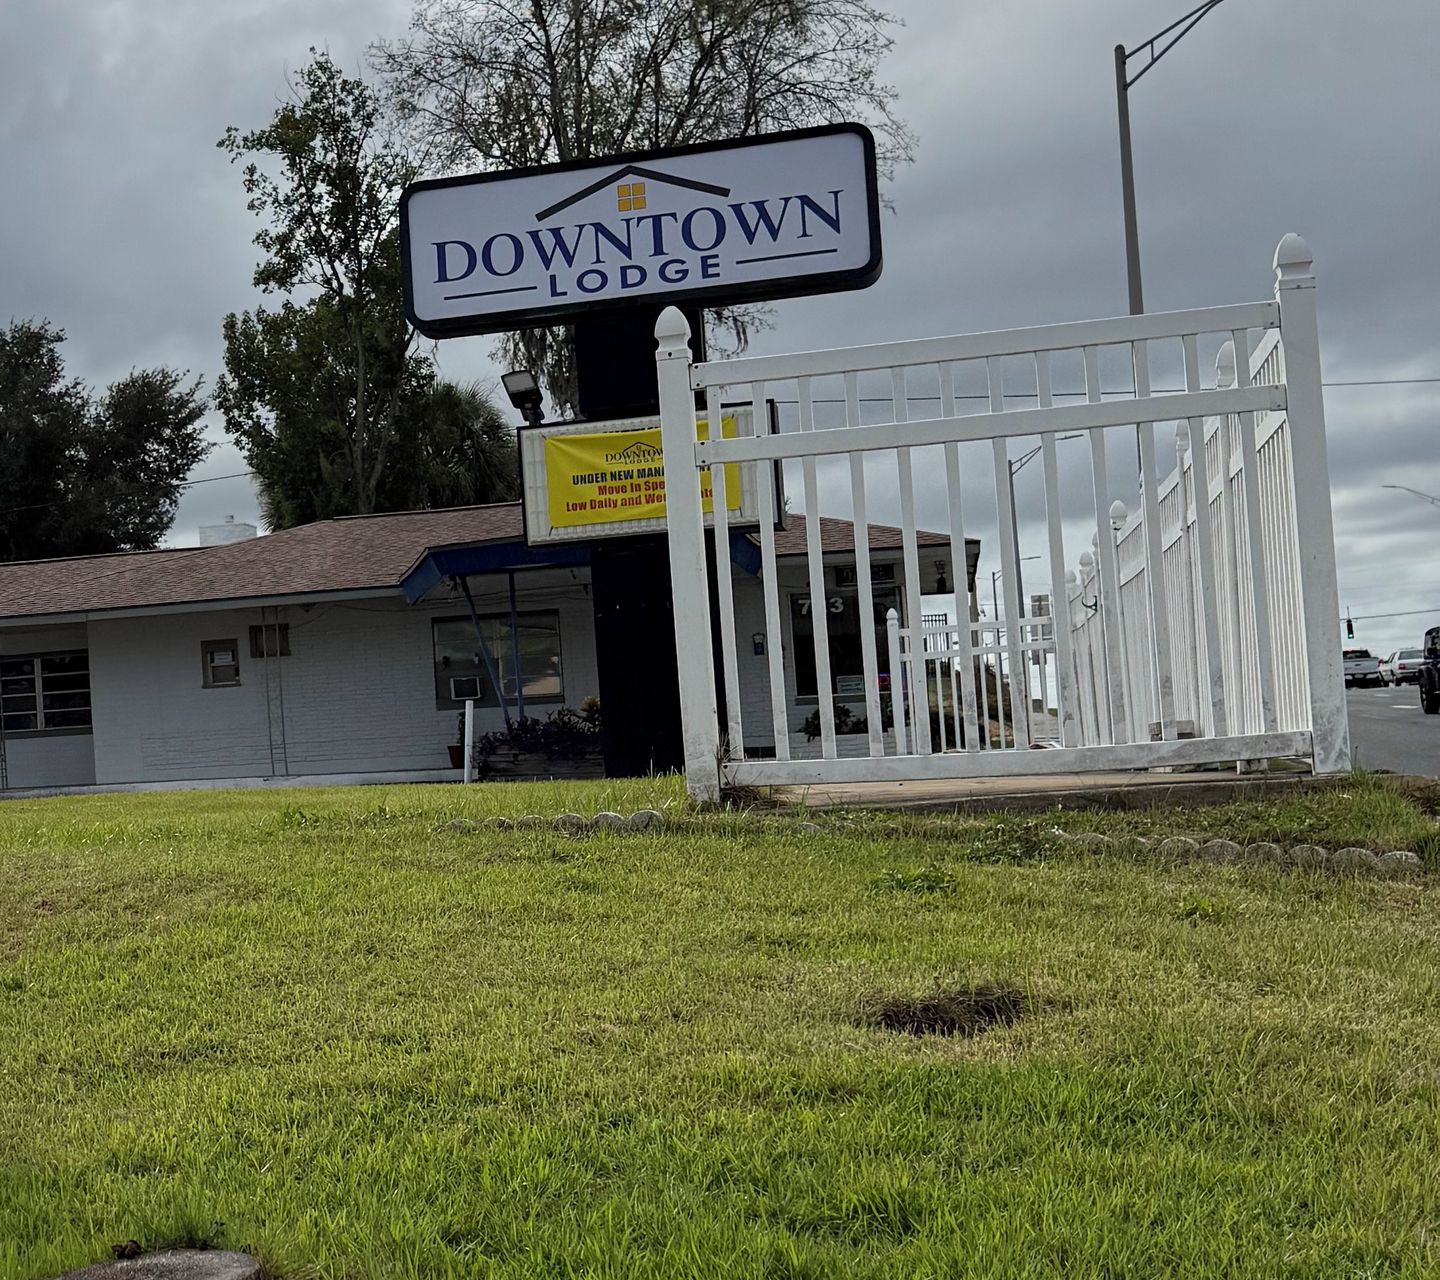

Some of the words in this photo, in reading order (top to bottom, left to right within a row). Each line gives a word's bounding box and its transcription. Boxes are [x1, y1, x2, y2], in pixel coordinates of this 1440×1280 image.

[431, 189, 845, 284] DOWNTOWN
[549, 254, 721, 298] LODGE
[605, 448, 663, 462] DOWNTOW
[572, 472, 607, 485] UNDER
[610, 469, 634, 482] NEW
[598, 484, 627, 496] Move
[630, 482, 642, 492] In
[566, 501, 587, 512] Low
[590, 497, 618, 510] Daily
[621, 494, 642, 507] and
[798, 597, 844, 615] 73
